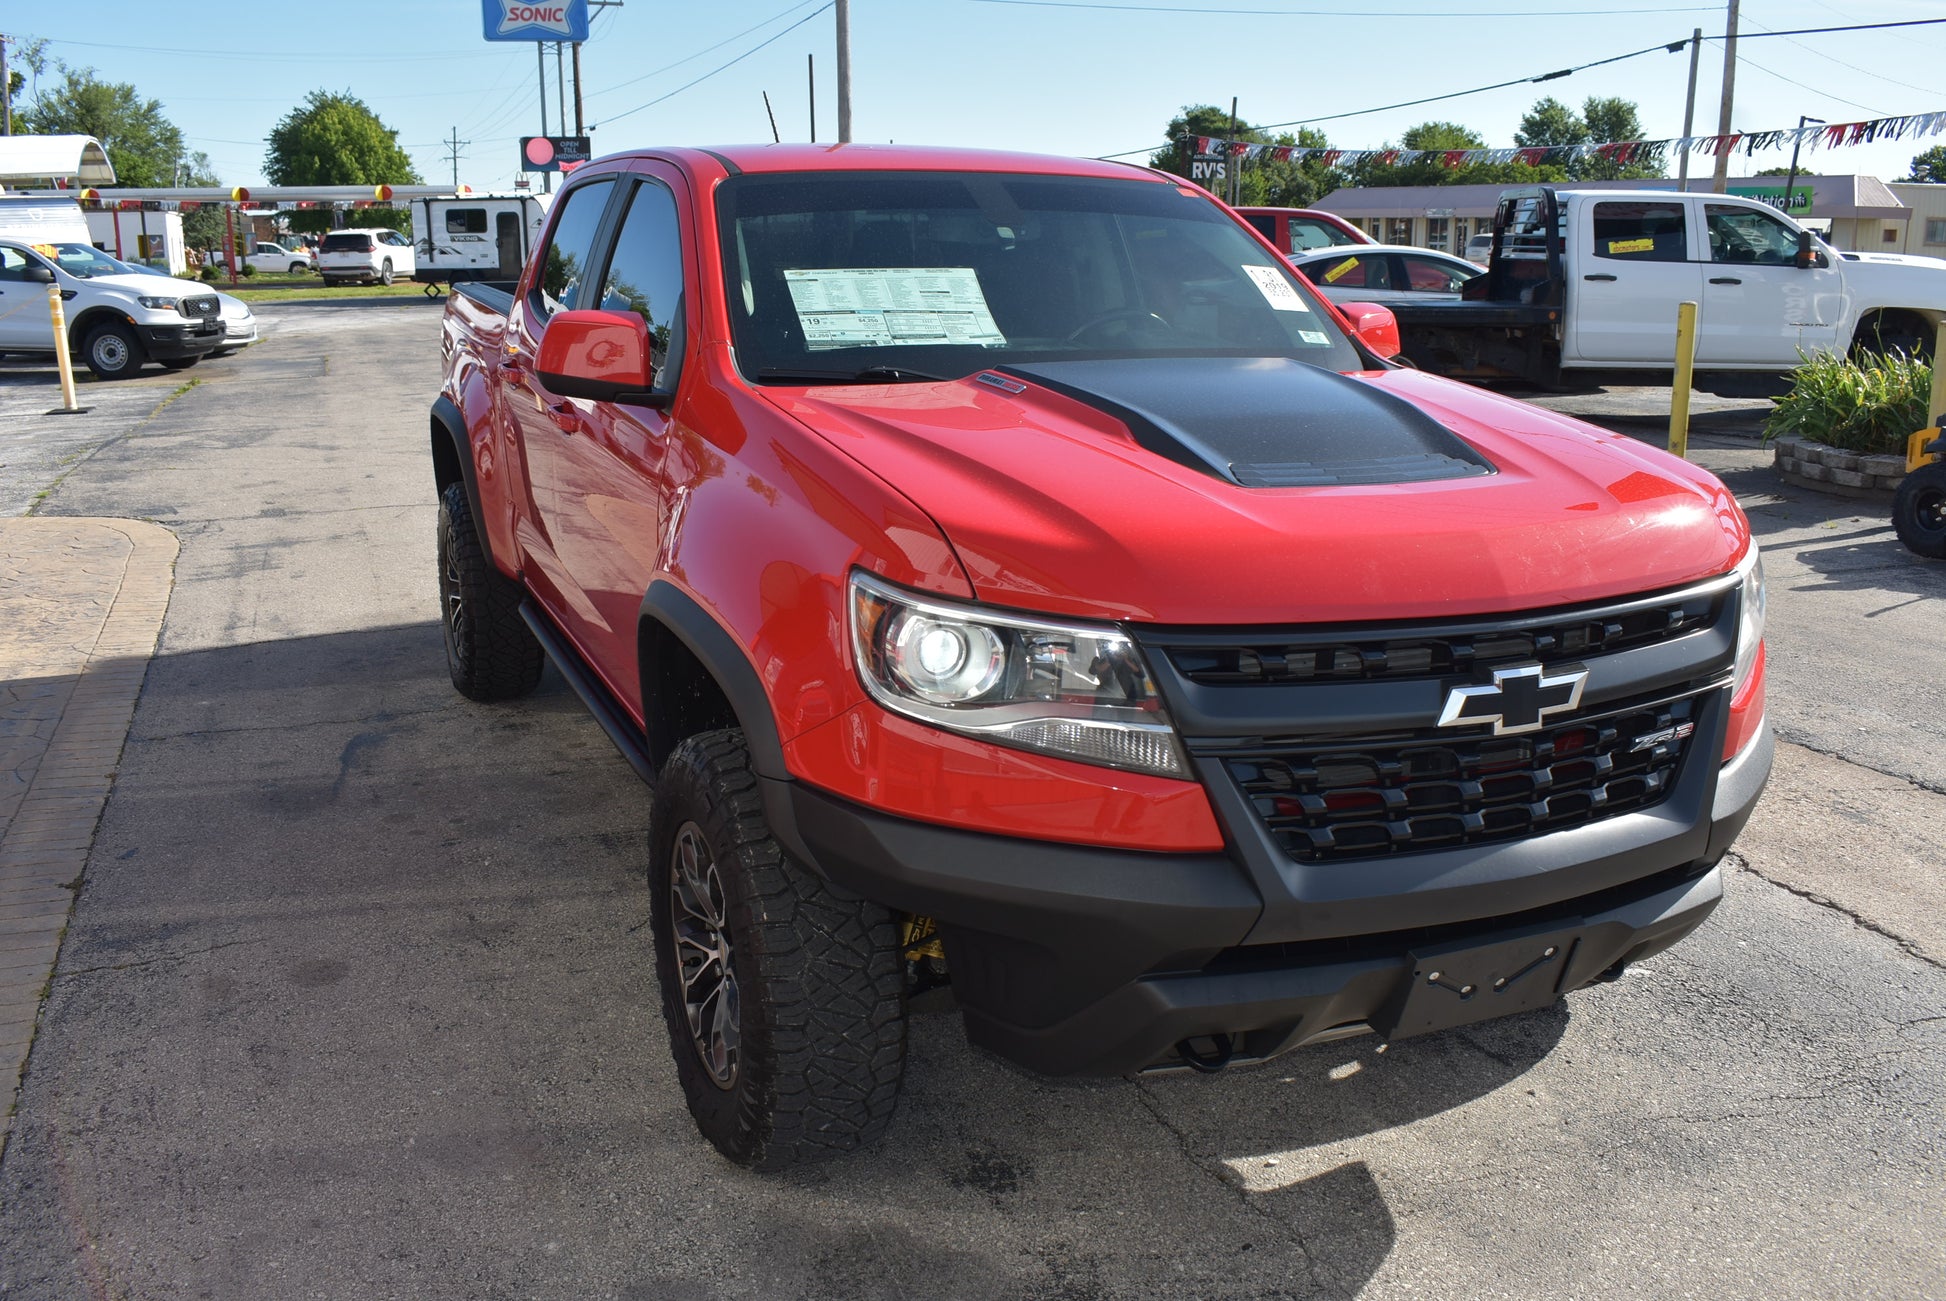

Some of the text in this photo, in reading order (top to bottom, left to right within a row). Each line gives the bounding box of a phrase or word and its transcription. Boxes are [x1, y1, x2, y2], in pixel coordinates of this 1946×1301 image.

[507, 7, 564, 22] SONIC
[1192, 161, 1226, 179] RV'S
[1630, 722, 1694, 753] ZR2
